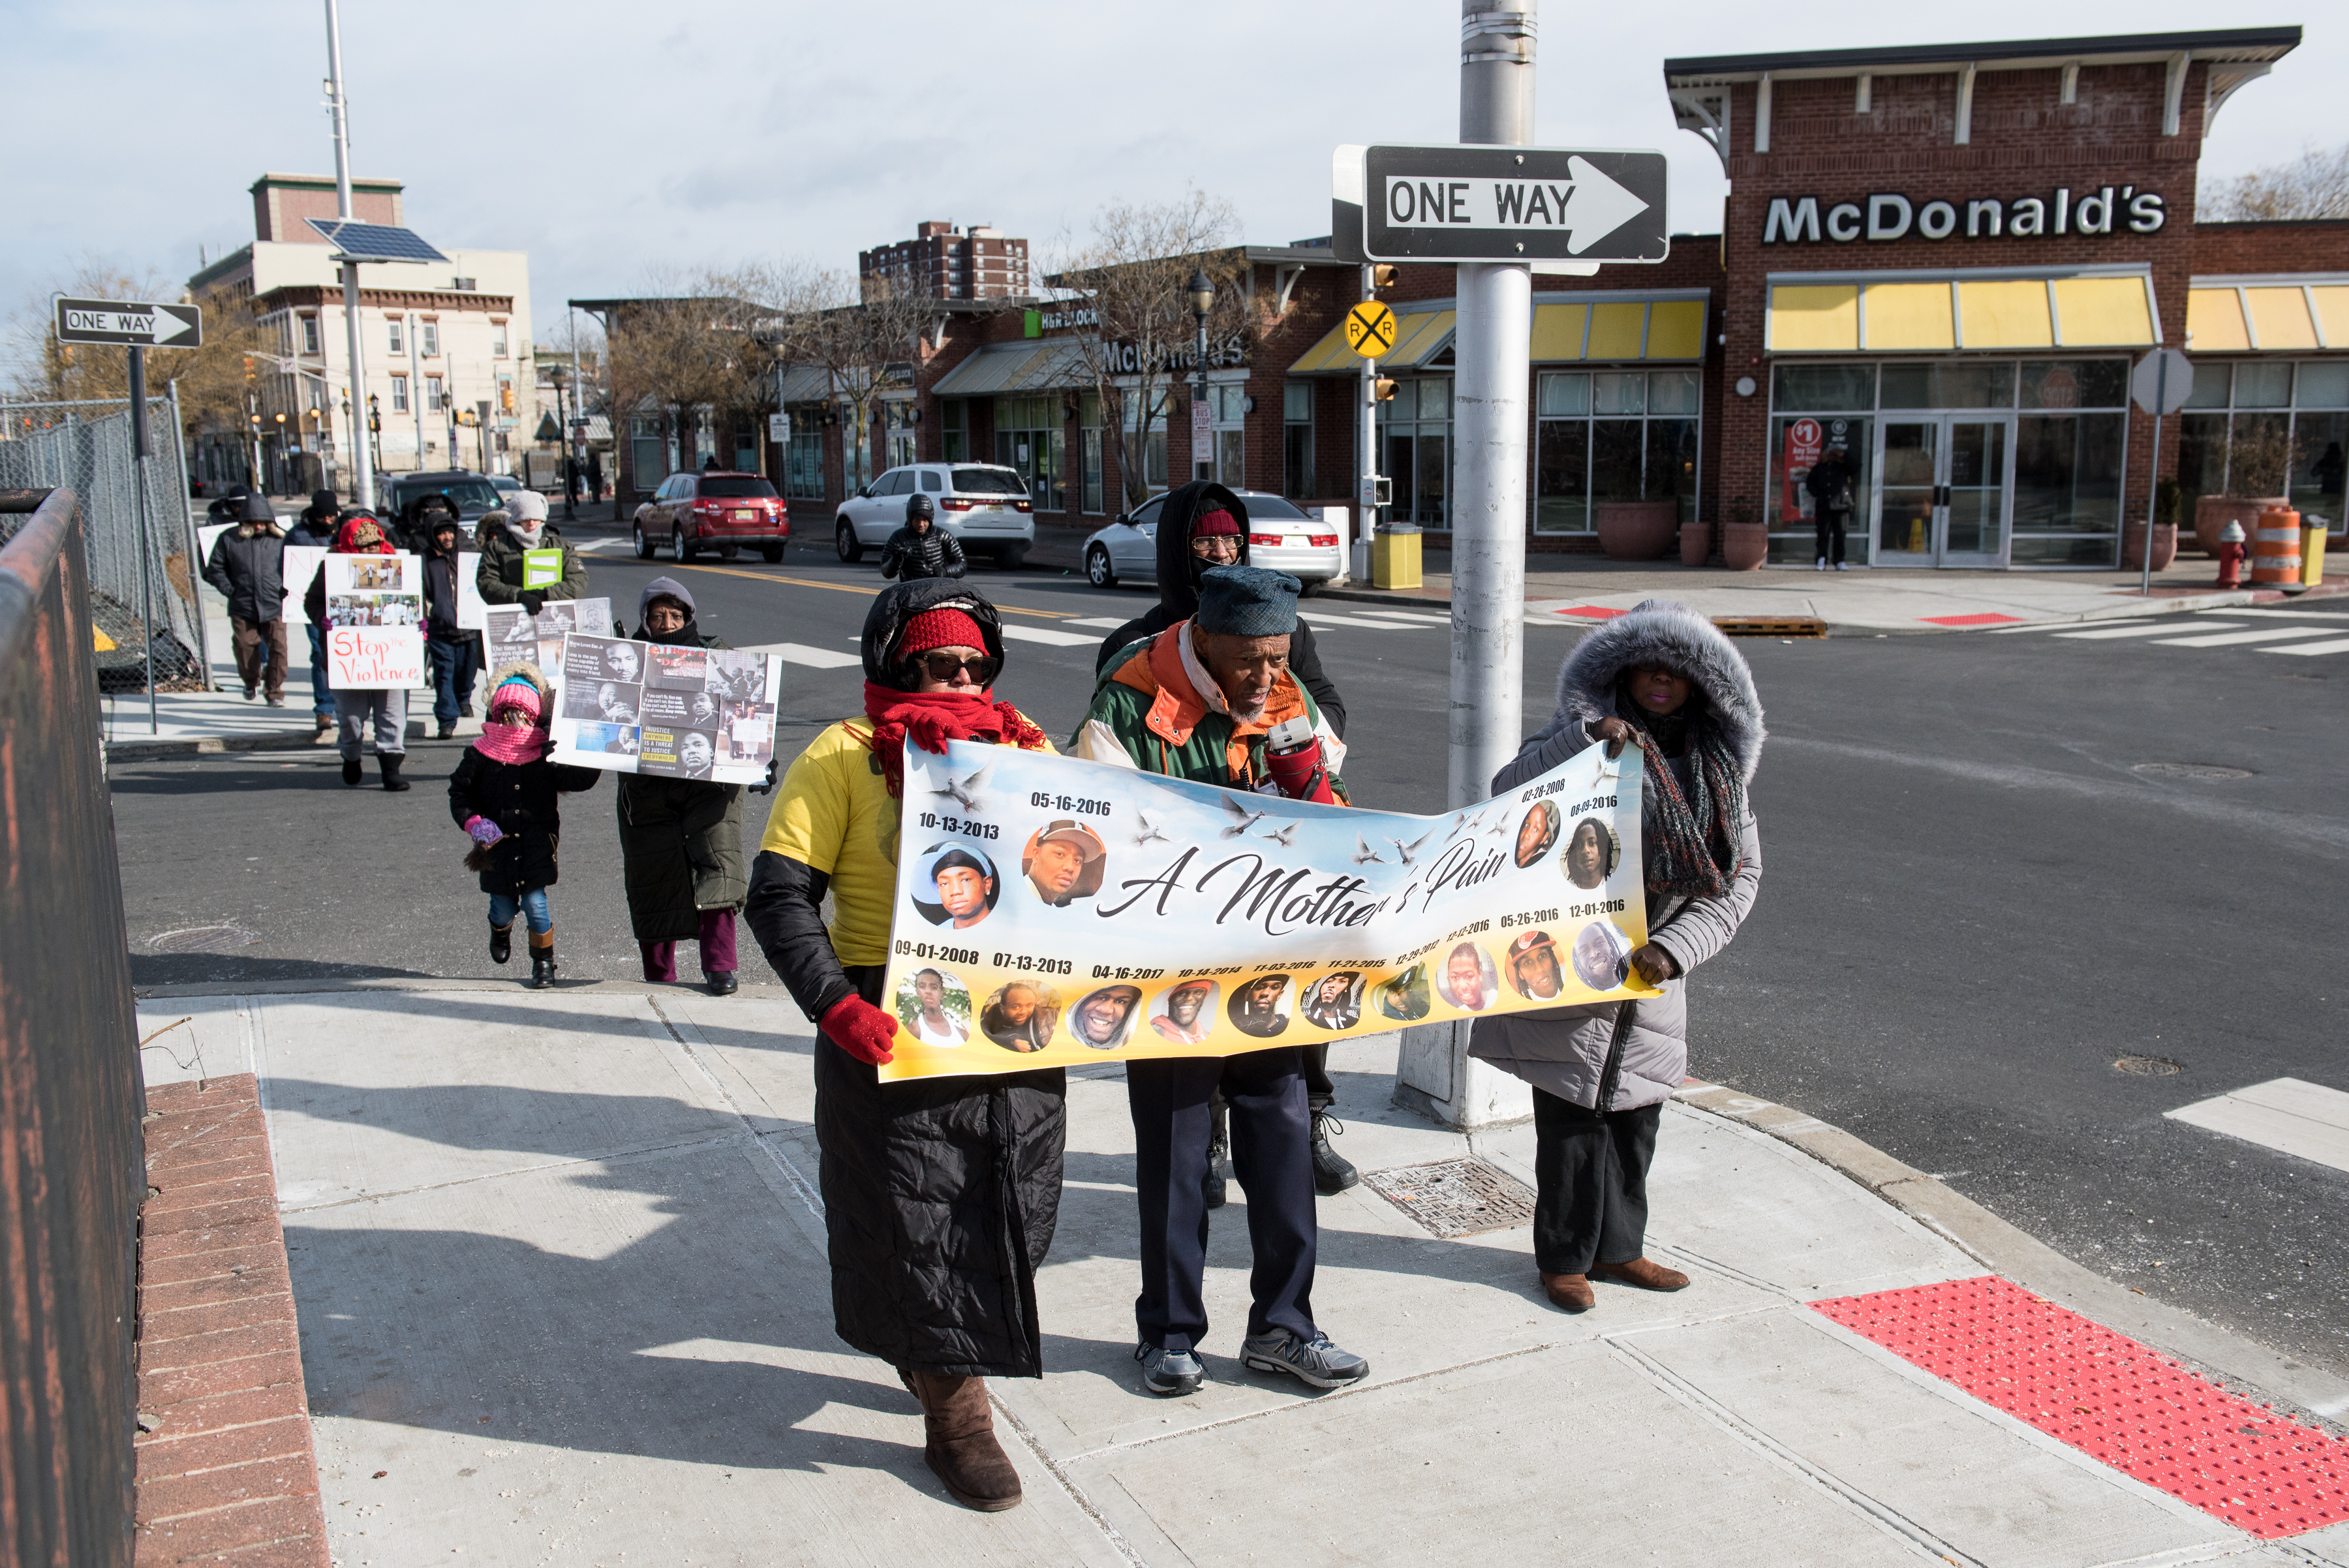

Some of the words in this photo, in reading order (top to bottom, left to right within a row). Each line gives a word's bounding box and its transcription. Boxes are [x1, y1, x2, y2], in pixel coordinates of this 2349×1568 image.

[1390, 181, 1471, 223] ONE
[1494, 183, 1576, 224] WAY
[1764, 186, 2165, 243] McDonald's
[69, 312, 106, 329] ONE
[117, 315, 156, 332] WAY
[1042, 312, 1062, 328] H&R
[1064, 308, 1098, 326] BLOCK
[1350, 323, 1360, 337] R
[1383, 322, 1392, 335] R
[1796, 423, 1813, 442] $1
[1792, 447, 1805, 455] Any
[334, 632, 389, 665] Stop
[671, 647, 696, 656] Have
[338, 658, 419, 683] Violence
[645, 733, 671, 741] ANYWHERE
[646, 726, 670, 734] INJUSTICE
[643, 753, 675, 761] EVERYWHERE
[1522, 778, 1565, 803] 02-28-2008
[1031, 792, 1111, 816] 05-16-2016
[1571, 795, 1618, 817] 08-09-2016
[919, 812, 1000, 840] 10-13-2013
[1097, 846, 1200, 917] A
[1196, 853, 1419, 936] Mother's
[1422, 838, 1509, 914] Pain
[895, 940, 979, 965] 09-01-2008
[993, 952, 1072, 975] 07-13-2013
[1092, 964, 1165, 979] 04-16-2017
[1177, 966, 1243, 978] 10-14-2014
[1253, 961, 1317, 972] 11-03-2016
[1327, 959, 1387, 968] 11-21-2015
[1395, 939, 1440, 966] 12-29-2012
[1446, 919, 1490, 942] 12-12-2016
[1501, 908, 1559, 928] 05-26-2016
[1569, 899, 1625, 917] 12-01-2016
